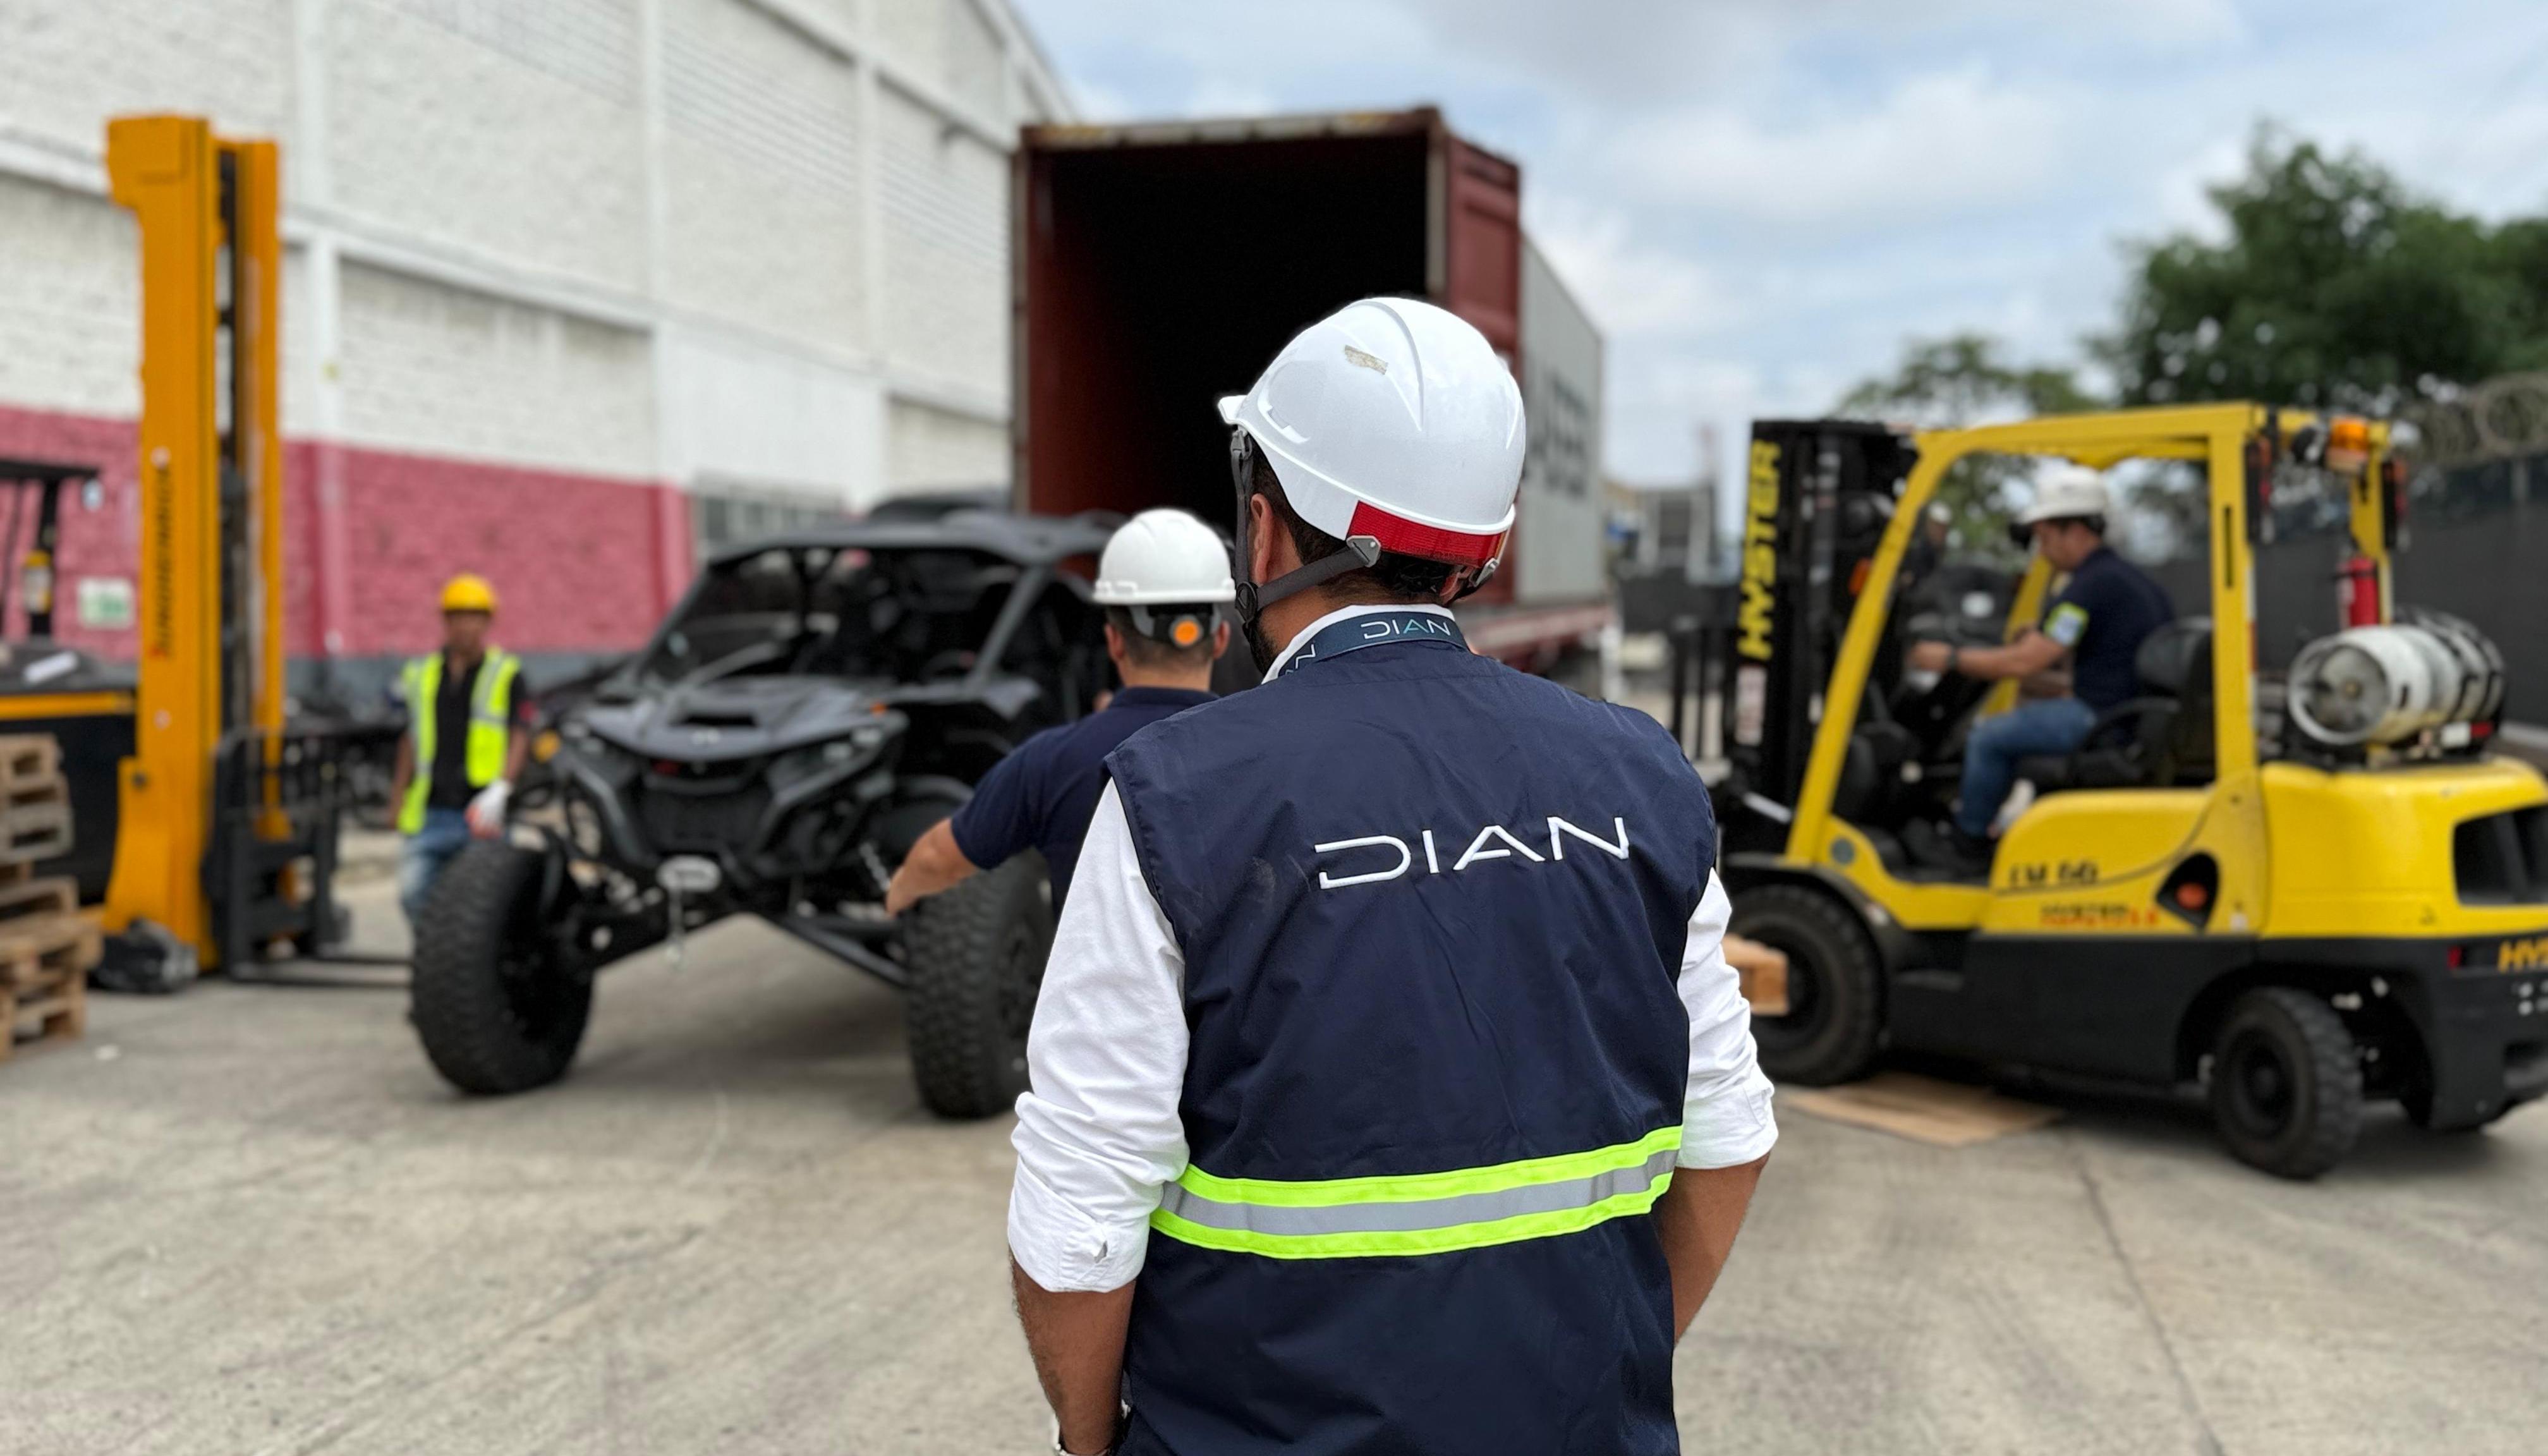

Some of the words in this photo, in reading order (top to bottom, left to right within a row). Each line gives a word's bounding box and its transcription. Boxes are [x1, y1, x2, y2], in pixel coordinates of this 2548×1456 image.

[1737, 439, 1781, 660] HYSTER
[1361, 619, 1451, 639] DIAN
[1314, 815, 1630, 890] DIAN
